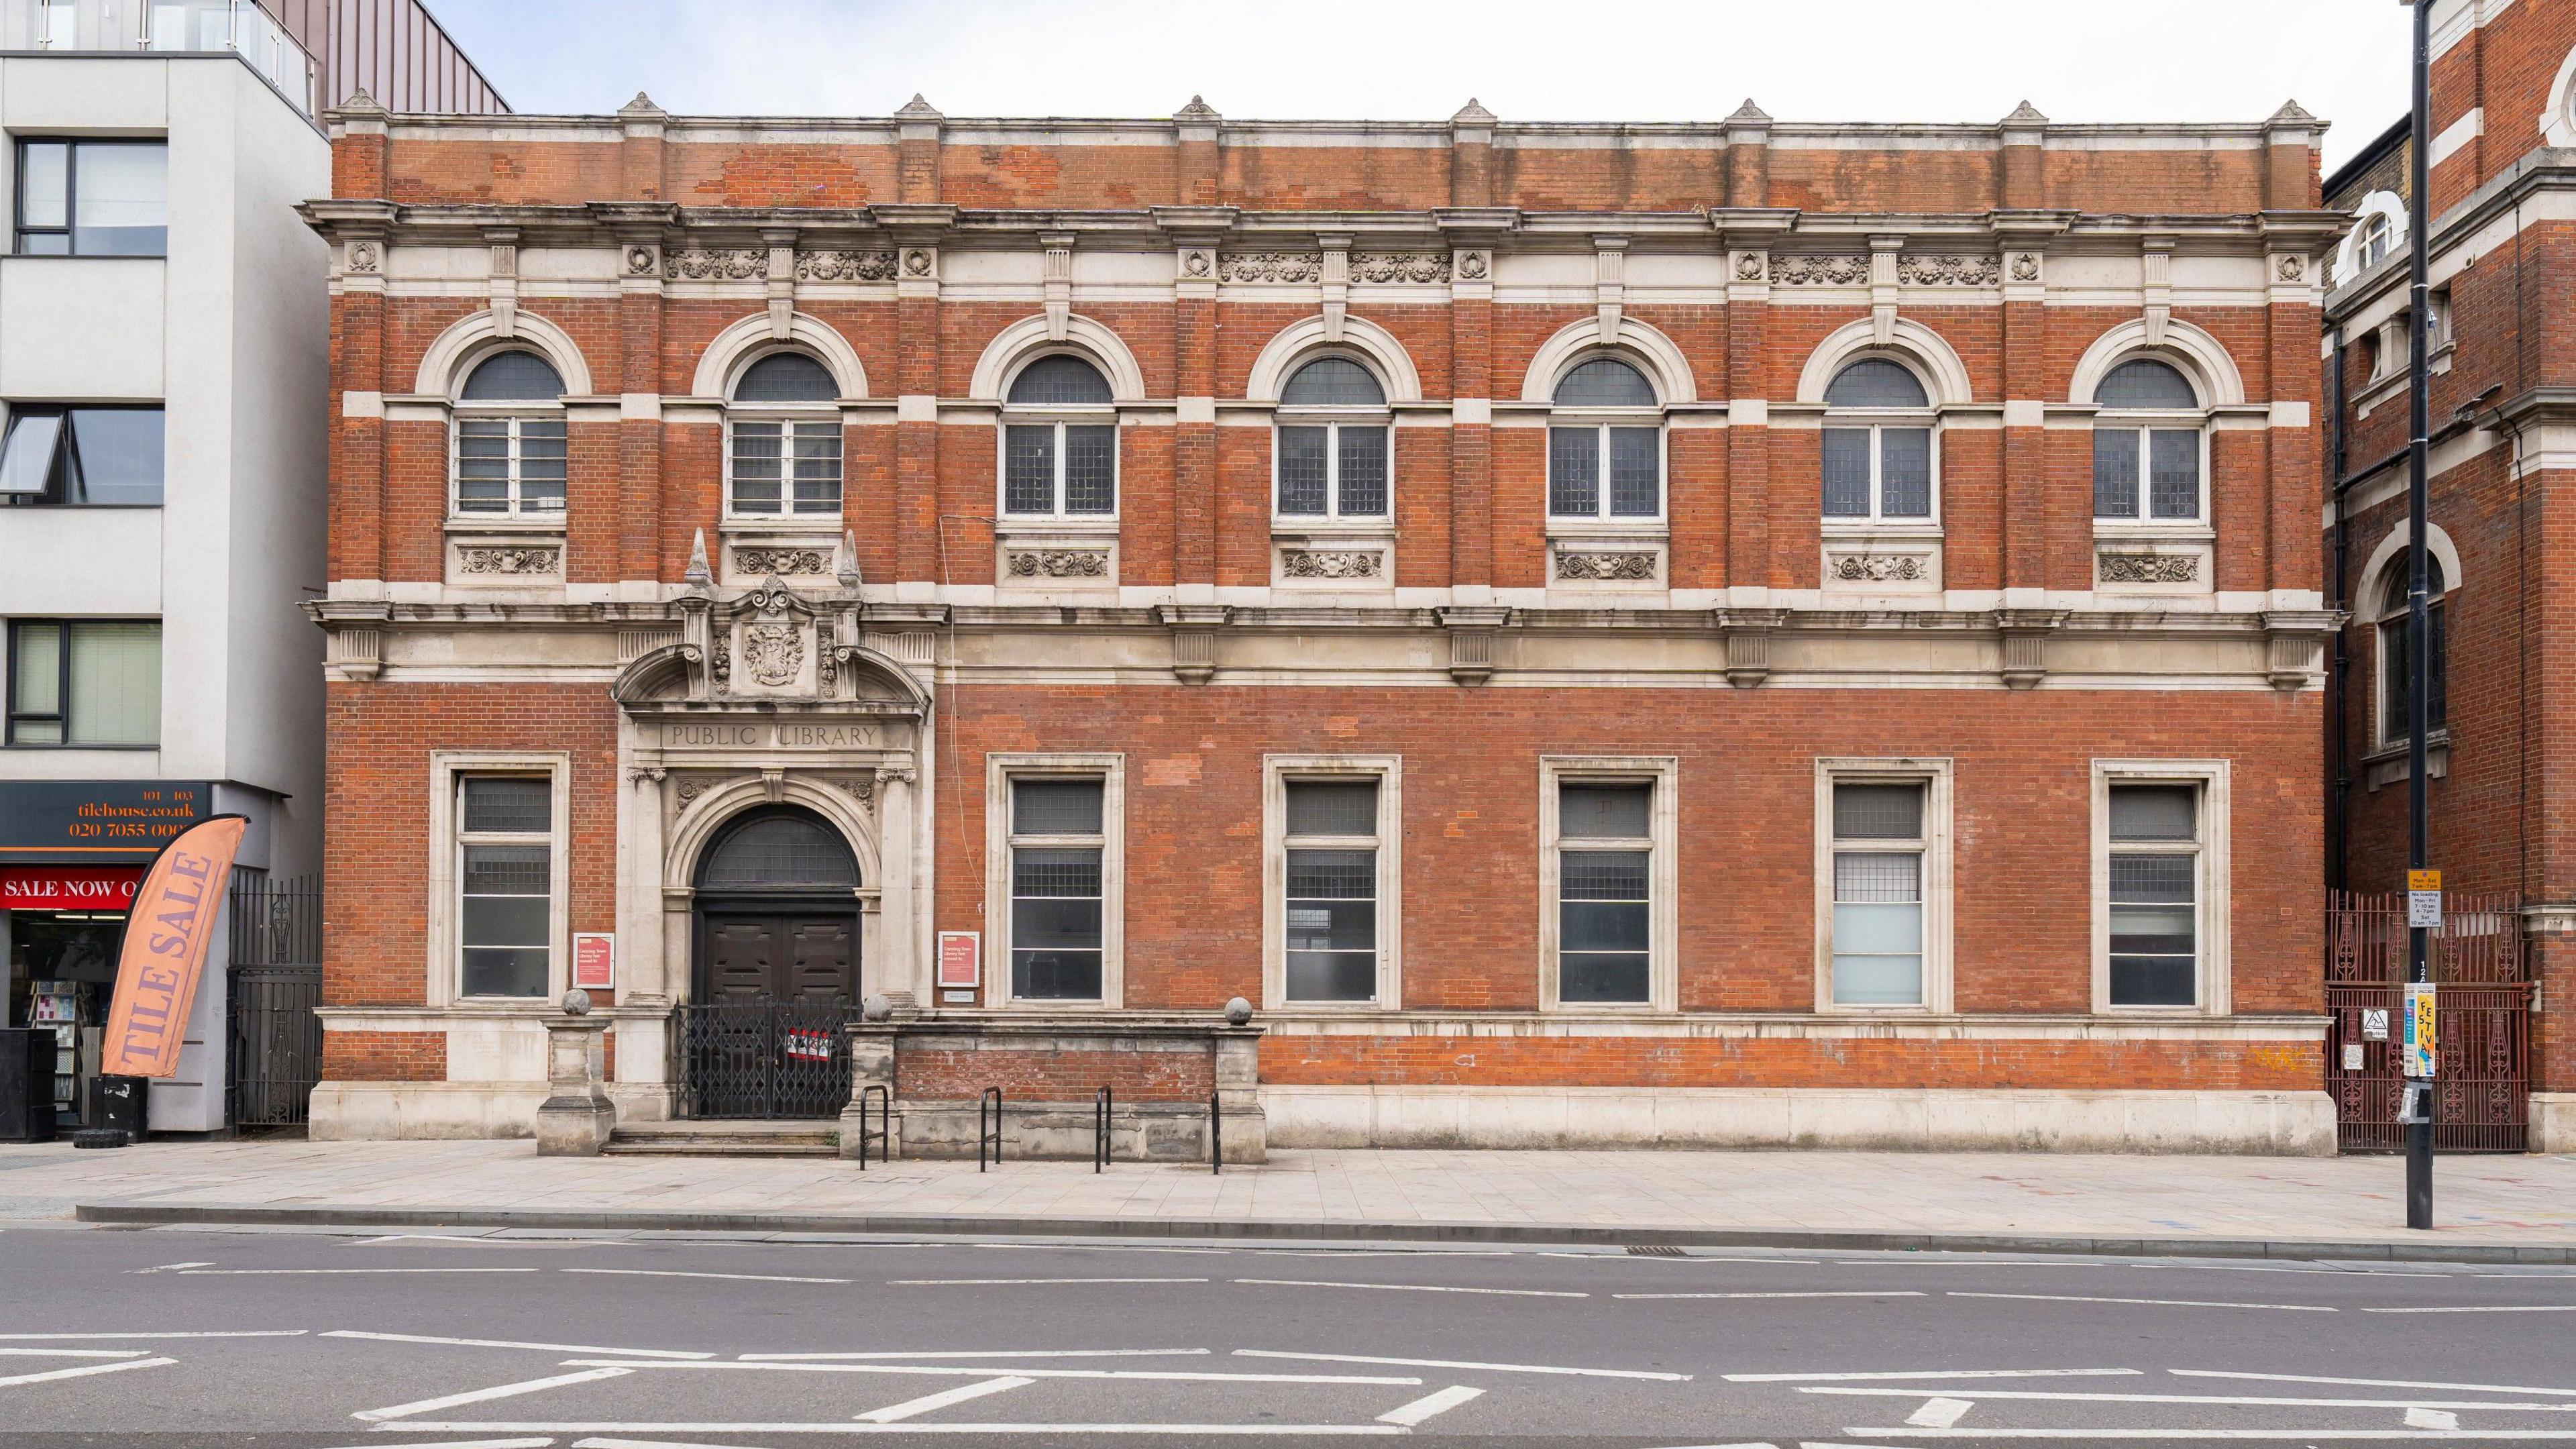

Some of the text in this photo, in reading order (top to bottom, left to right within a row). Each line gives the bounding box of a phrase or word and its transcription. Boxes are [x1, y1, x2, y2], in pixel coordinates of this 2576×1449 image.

[672, 727, 877, 746] PUBLIC LIBRARY
[143, 791, 160, 800] 101
[174, 791, 193, 800] 103
[78, 802, 194, 817] tilehouse.co.uk
[68, 824, 100, 837] 020
[107, 824, 145, 837] 7055
[5, 880, 139, 897] SALE NOW O
[121, 851, 212, 1064] TILE SALE
